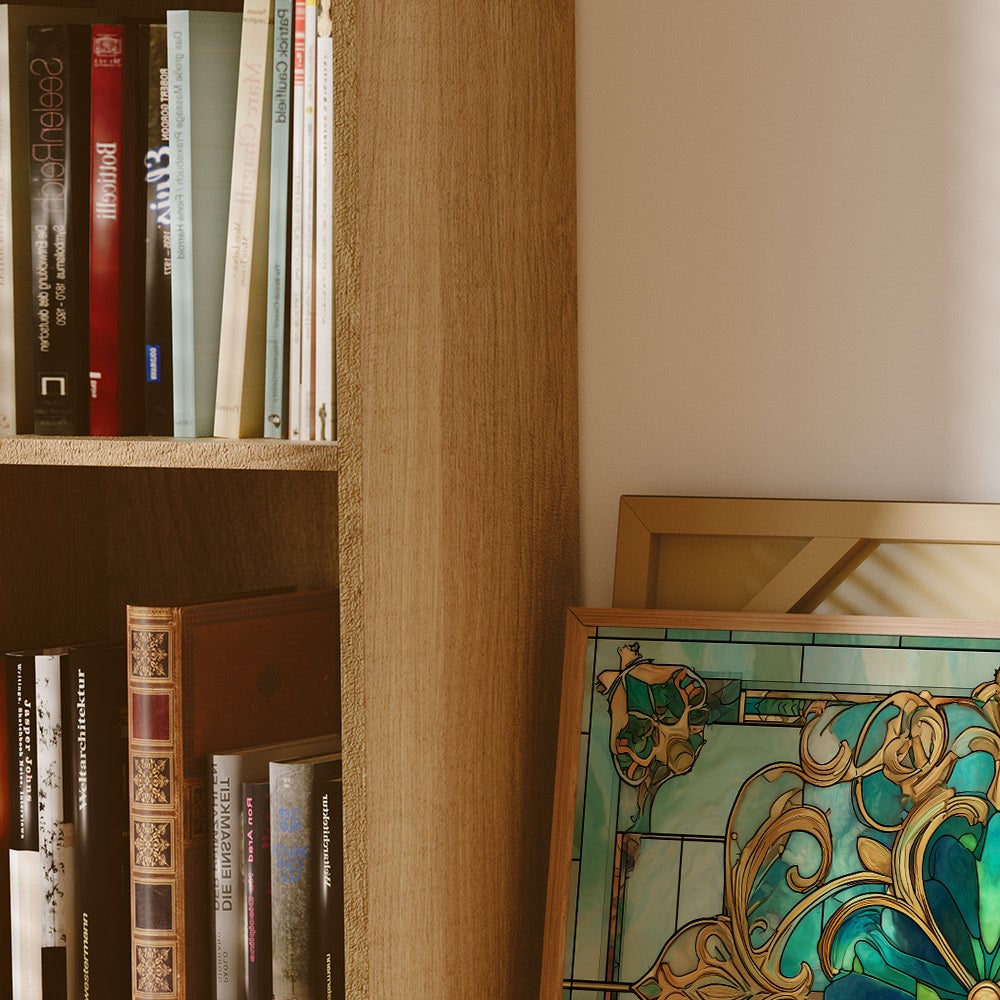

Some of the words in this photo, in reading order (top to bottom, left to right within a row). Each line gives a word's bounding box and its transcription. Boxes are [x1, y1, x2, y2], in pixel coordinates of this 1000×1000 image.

[24, 700, 32, 751] Jasper
[77, 668, 88, 811] Weltarchitektur
[25, 756, 33, 803] Johns
